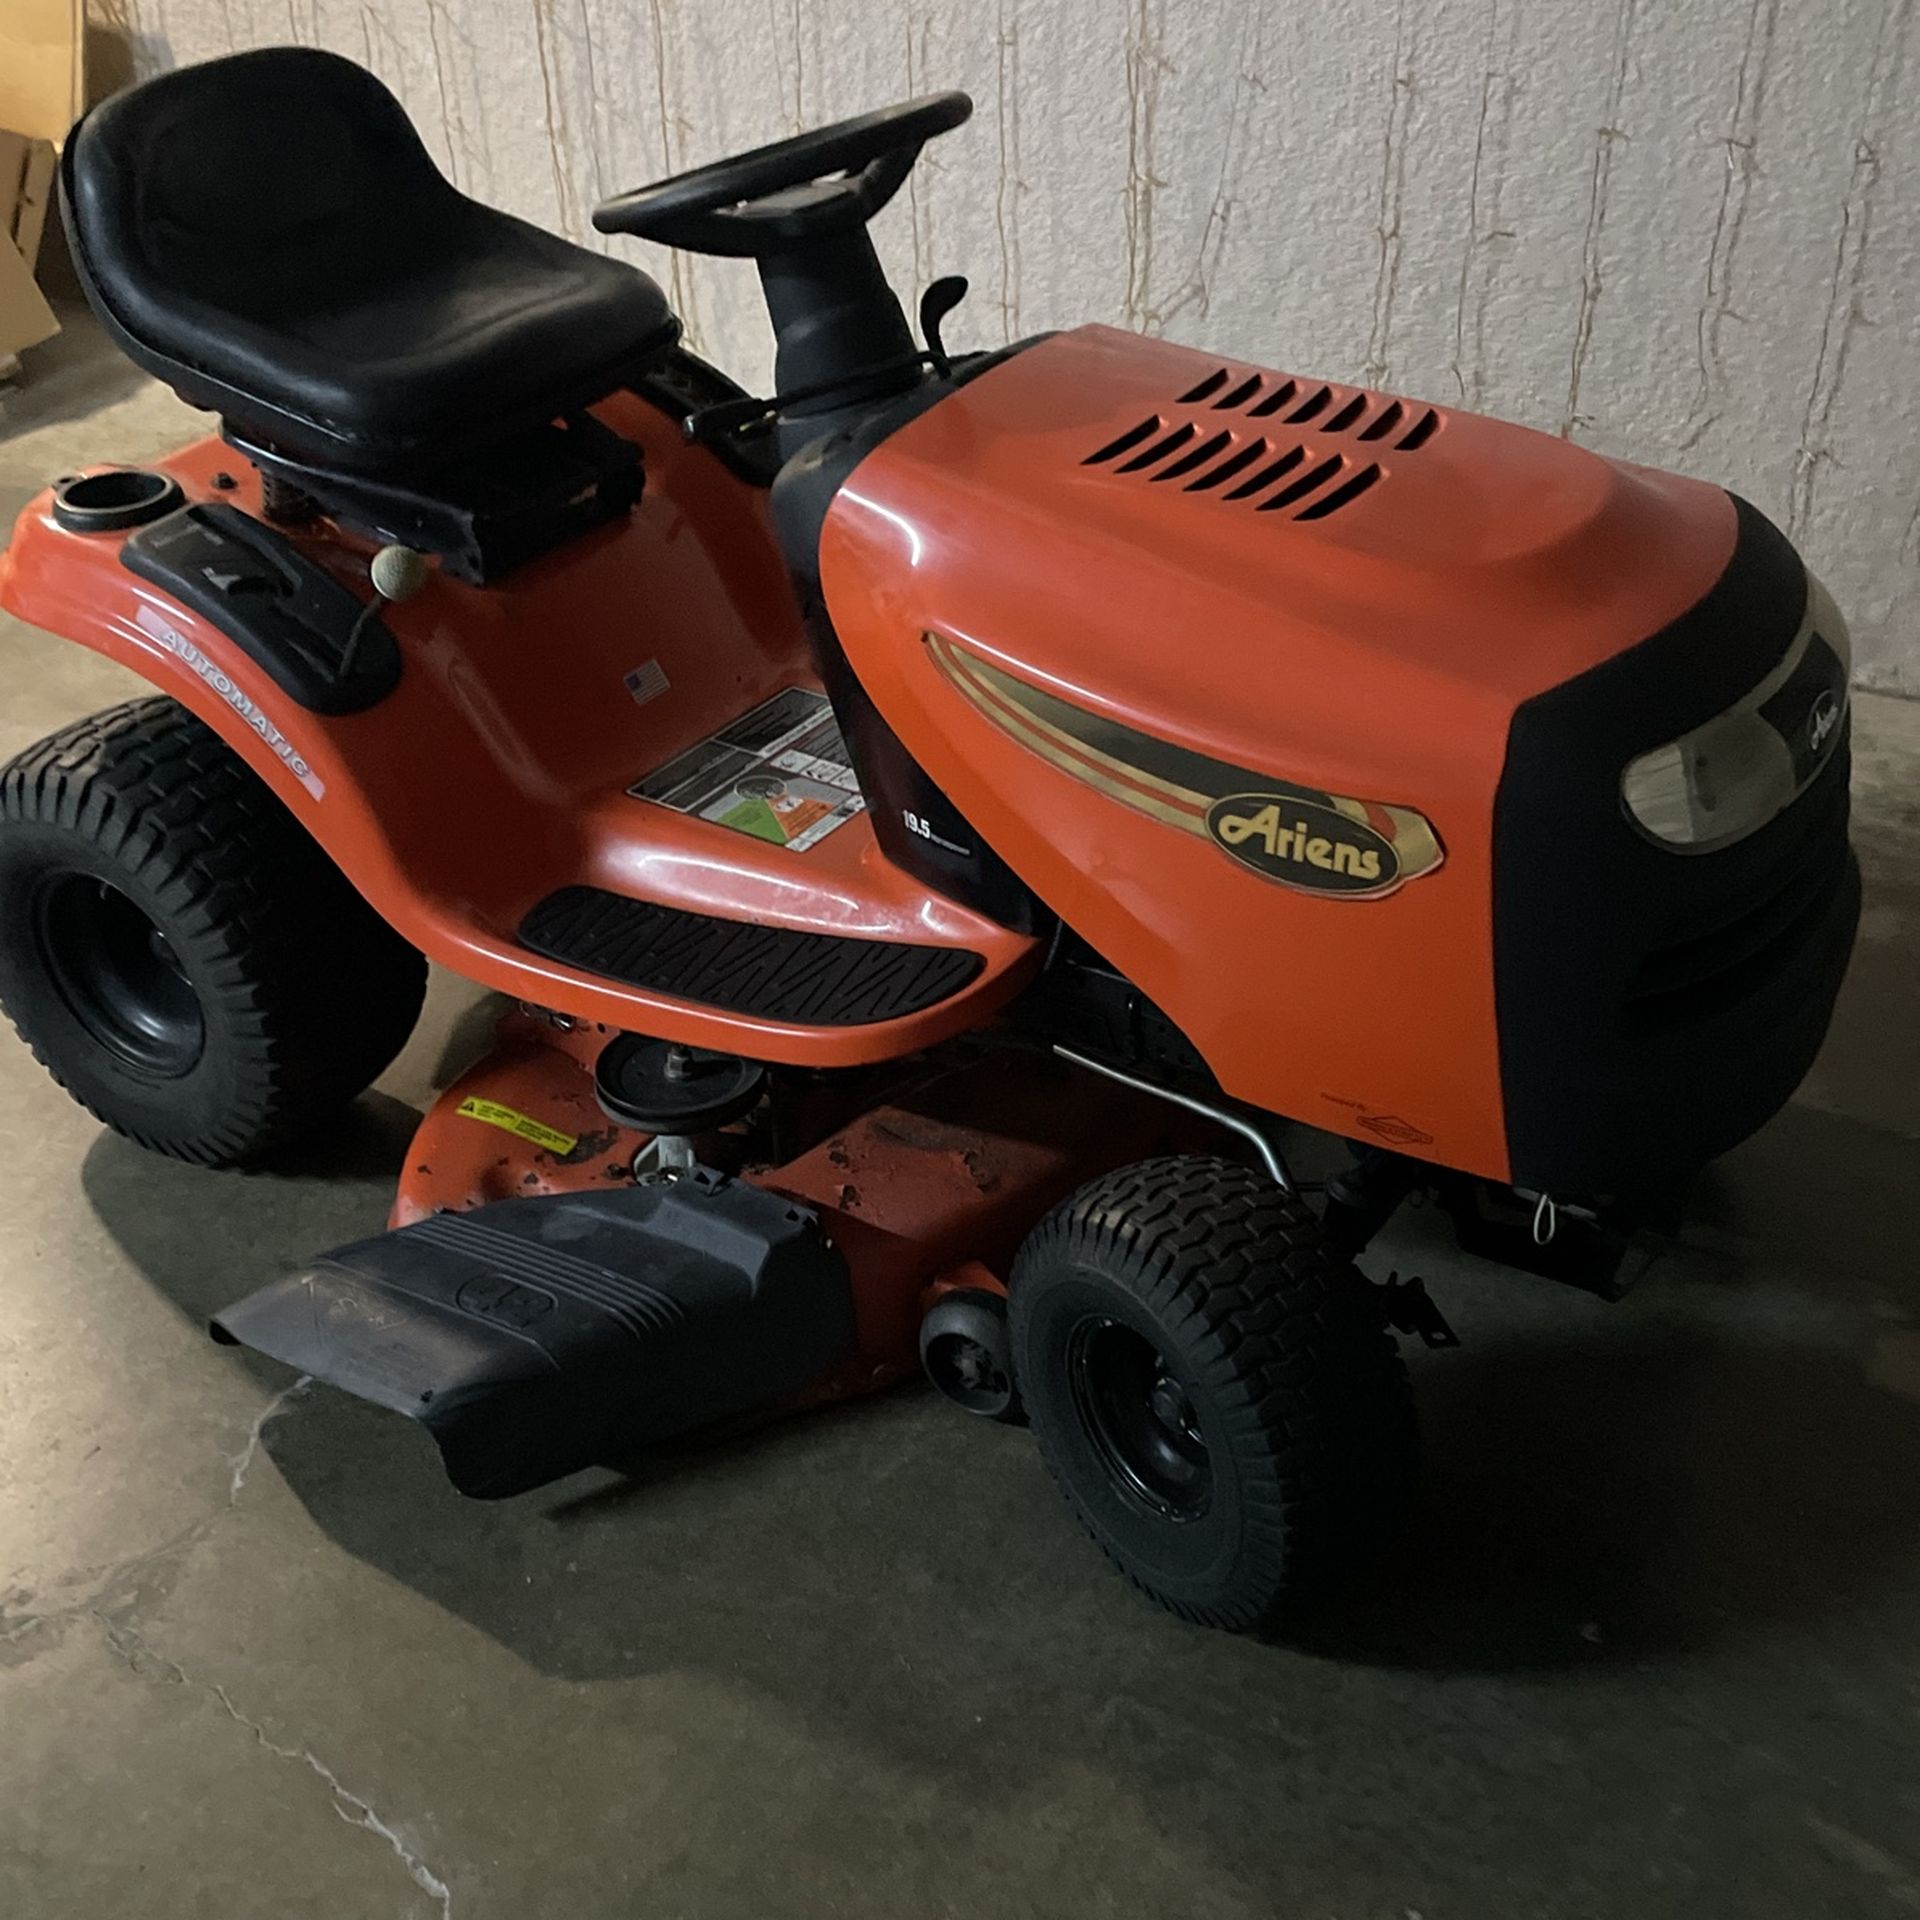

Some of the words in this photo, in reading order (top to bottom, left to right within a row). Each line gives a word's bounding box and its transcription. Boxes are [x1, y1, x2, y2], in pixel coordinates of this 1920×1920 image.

[161, 631, 310, 778] AUTOMATIC
[902, 809, 931, 839] 19.5
[1218, 804, 1381, 880] Ariens
